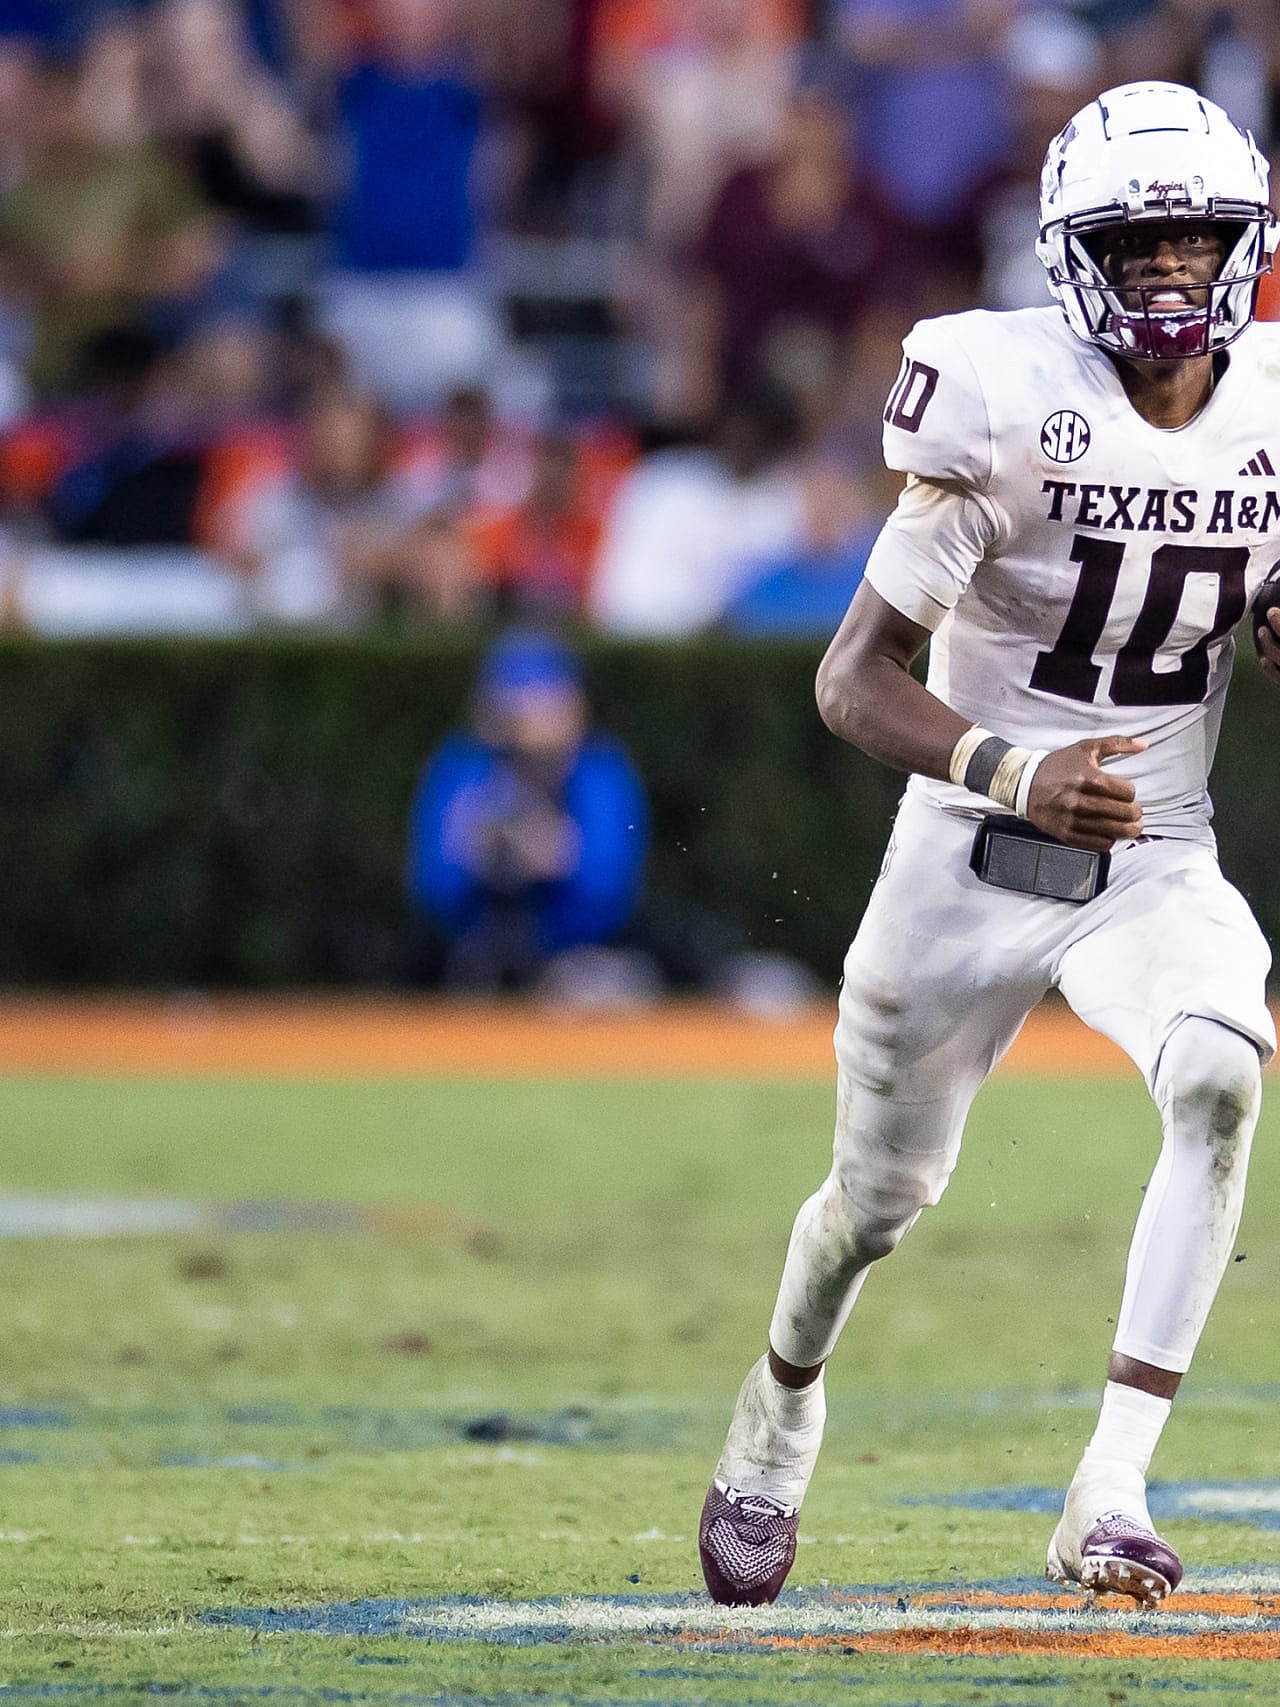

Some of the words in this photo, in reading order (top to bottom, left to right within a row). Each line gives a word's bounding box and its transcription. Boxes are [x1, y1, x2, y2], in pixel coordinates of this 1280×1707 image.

[1145, 180, 1185, 200] Aggies
[883, 356, 940, 434] 10
[1042, 411, 1089, 462] SEC
[1041, 479, 1198, 533] TEXAS
[1029, 533, 1252, 707] 10
